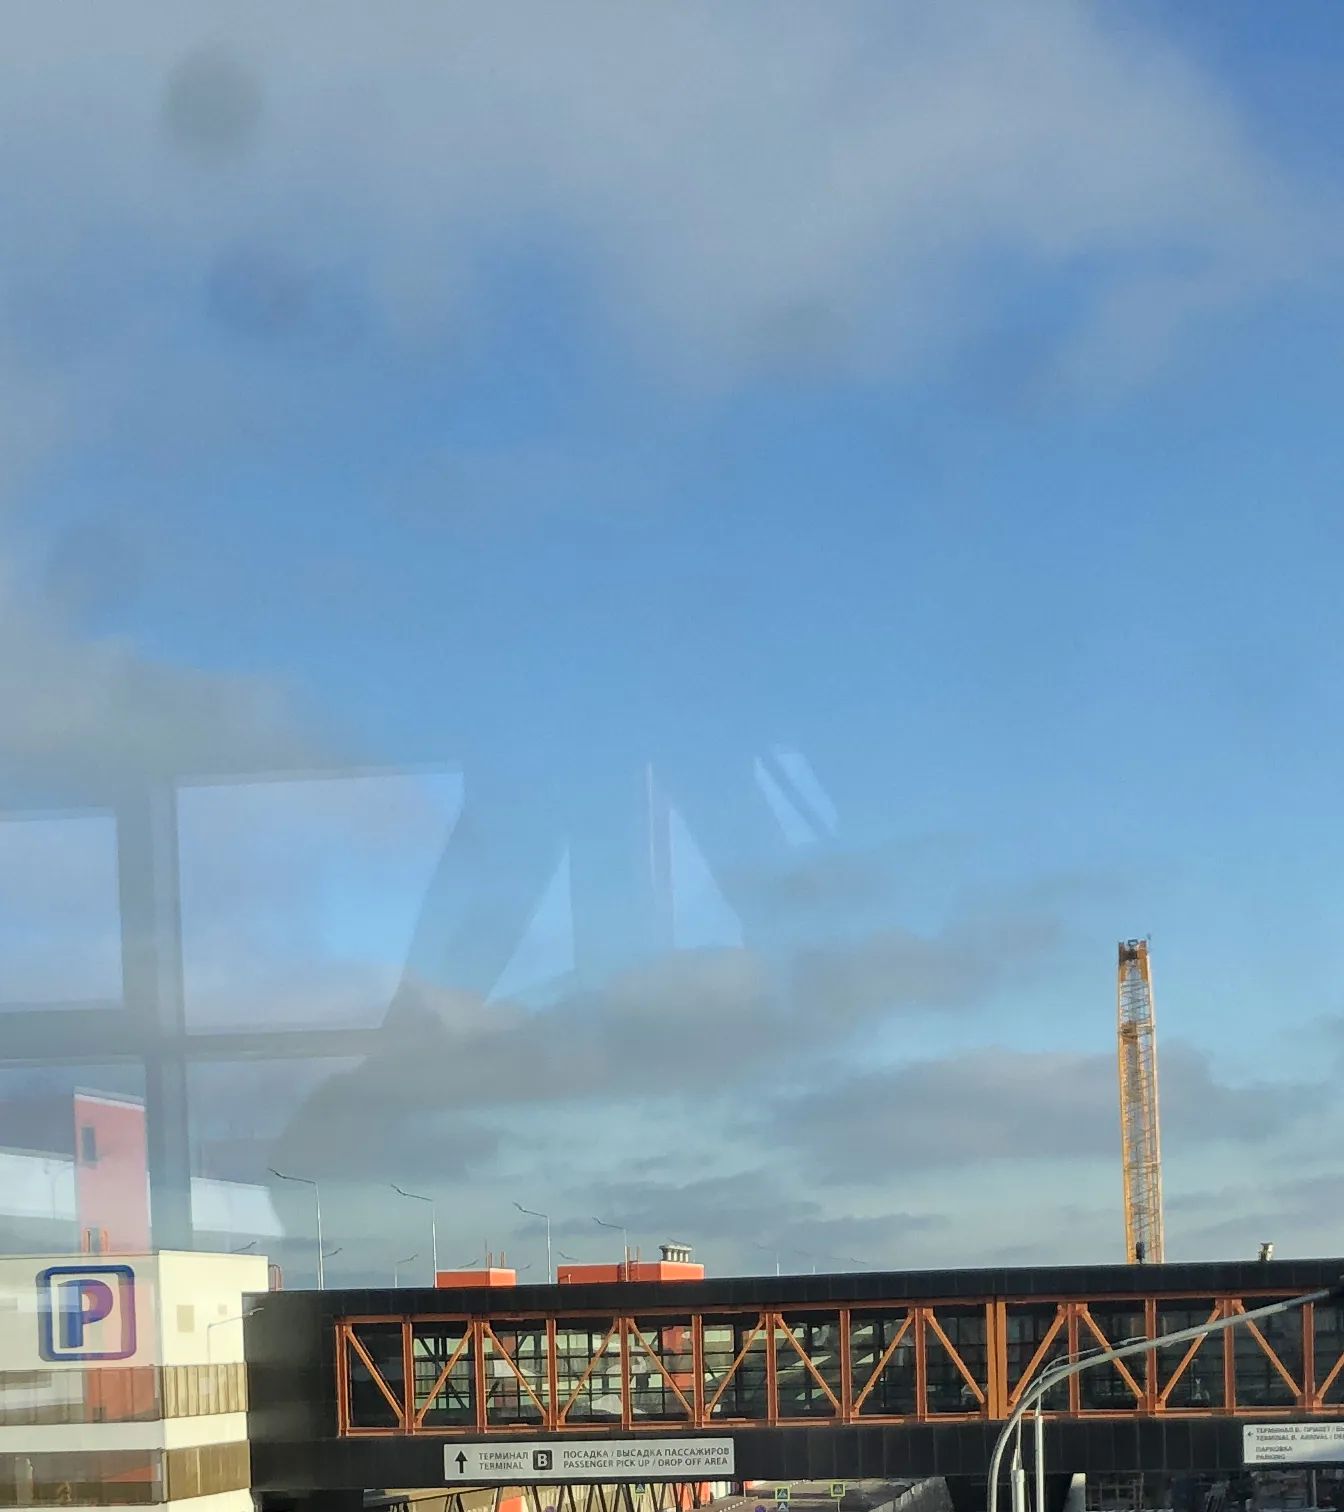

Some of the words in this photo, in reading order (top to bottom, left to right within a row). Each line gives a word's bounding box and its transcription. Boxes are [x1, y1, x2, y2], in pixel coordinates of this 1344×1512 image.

[57, 1279, 113, 1349] P
[478, 1451, 529, 1461] ТЕРМИНАЛ
[563, 1450, 609, 1460] ПОСАДКА
[616, 1449, 663, 1459] ВЫСАДКА
[664, 1447, 730, 1457] ПАССАЖИРОВ
[479, 1461, 524, 1470] TERMINAL
[537, 1453, 548, 1467] B
[563, 1459, 614, 1469] PASSENGER
[616, 1458, 636, 1468] PICK
[638, 1459, 650, 1467] UP
[657, 1458, 683, 1467] DROP
[684, 1457, 703, 1466] OFF
[704, 1457, 728, 1466] AREA
